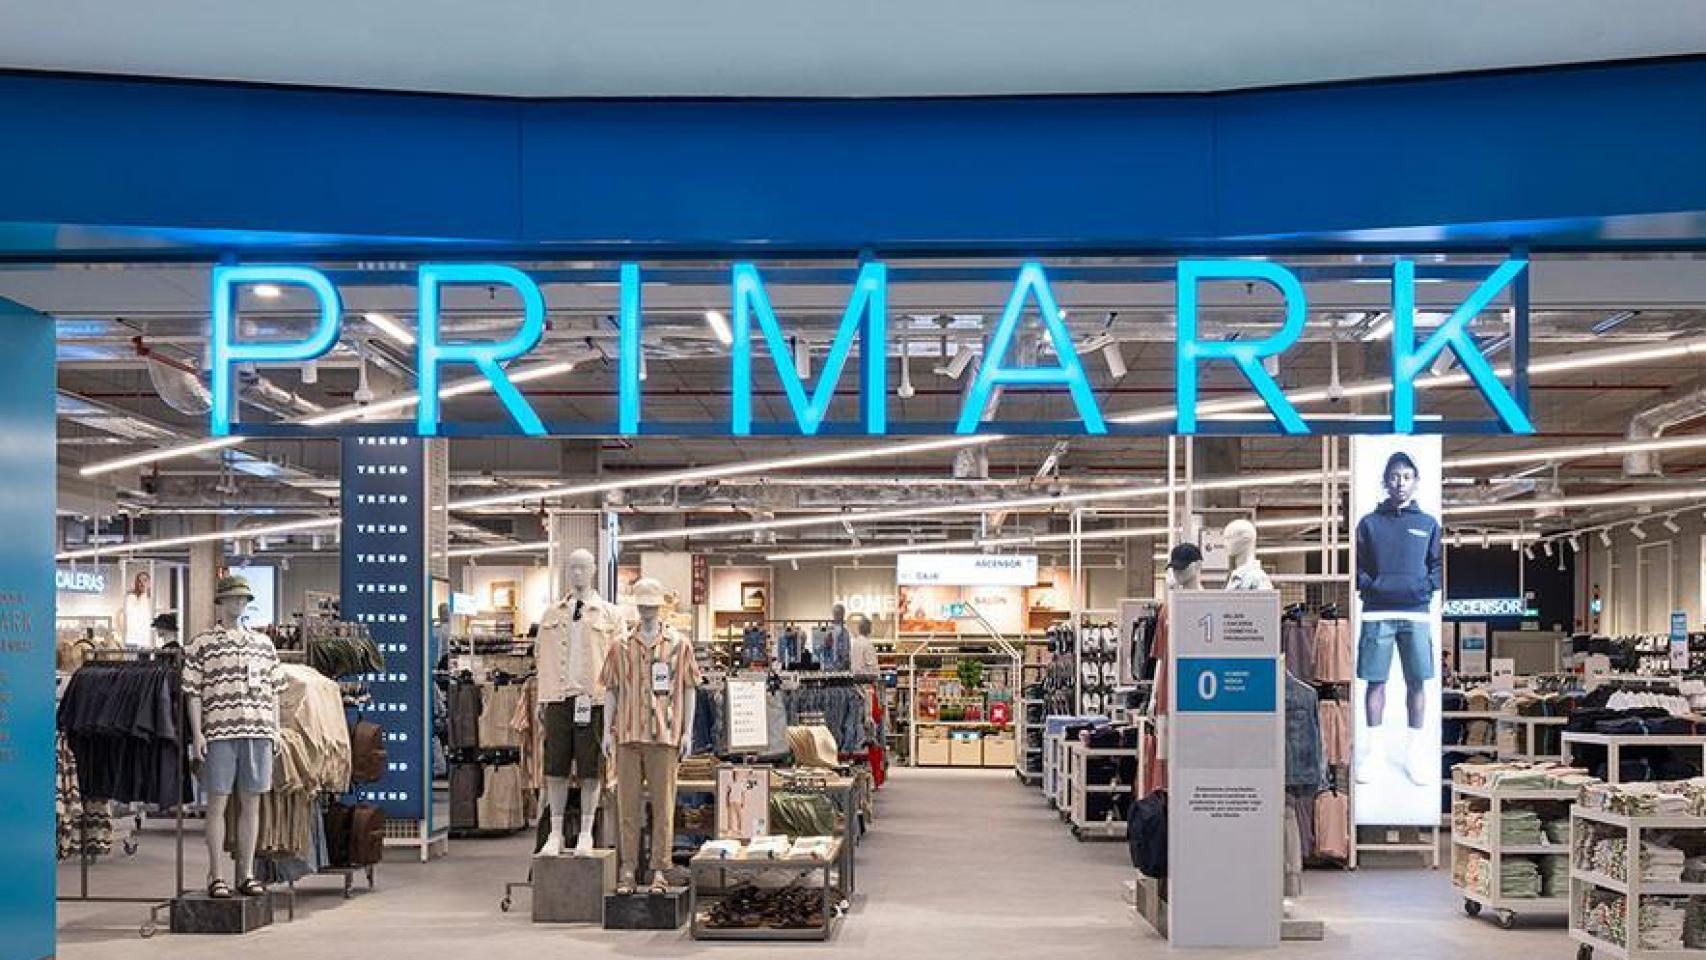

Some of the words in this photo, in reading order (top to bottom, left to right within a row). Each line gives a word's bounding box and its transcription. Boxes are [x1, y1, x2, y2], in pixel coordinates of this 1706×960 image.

[211, 258, 1535, 437] PRIMARK
[356, 436, 408, 446] TREND
[356, 465, 408, 474] TREND
[356, 494, 408, 503] TREND
[356, 524, 408, 534] TREND
[356, 554, 408, 563] TREND
[356, 584, 408, 592] TREND
[1443, 599, 1522, 616] ASCENSOR
[356, 613, 408, 623] TREND
[1198, 612, 1213, 643] 1
[378, 642, 408, 652] END
[1198, 671, 1217, 700] 0
